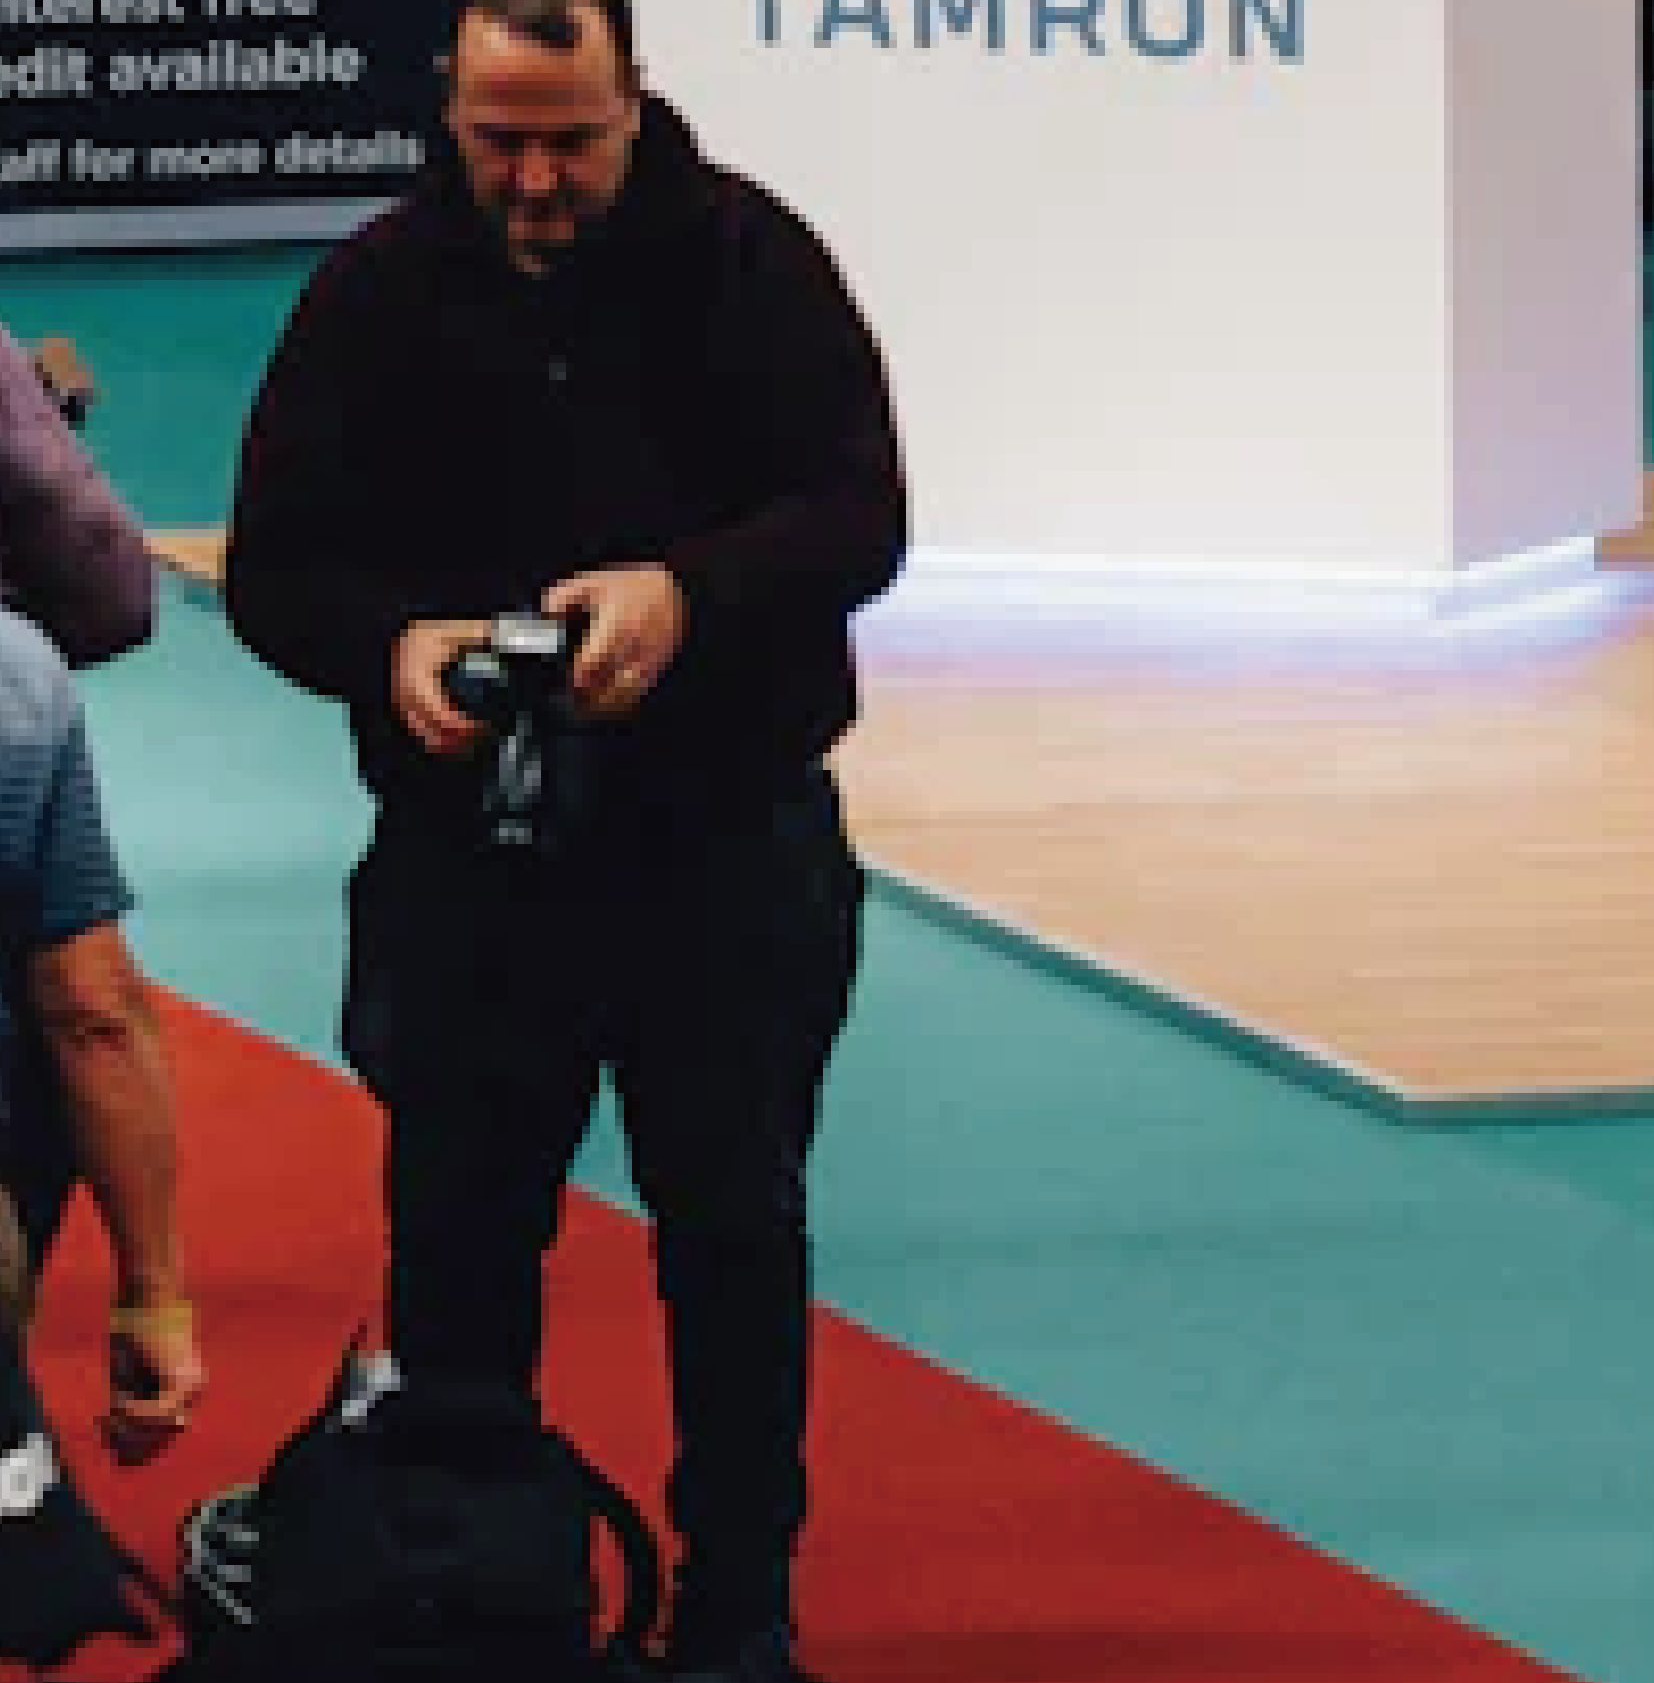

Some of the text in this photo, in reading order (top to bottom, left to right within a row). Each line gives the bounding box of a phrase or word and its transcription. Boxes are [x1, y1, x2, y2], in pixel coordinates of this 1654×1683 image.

[109, 32, 366, 91] available
[68, 138, 138, 182] for
[150, 144, 262, 176] more
[273, 128, 426, 175] details
